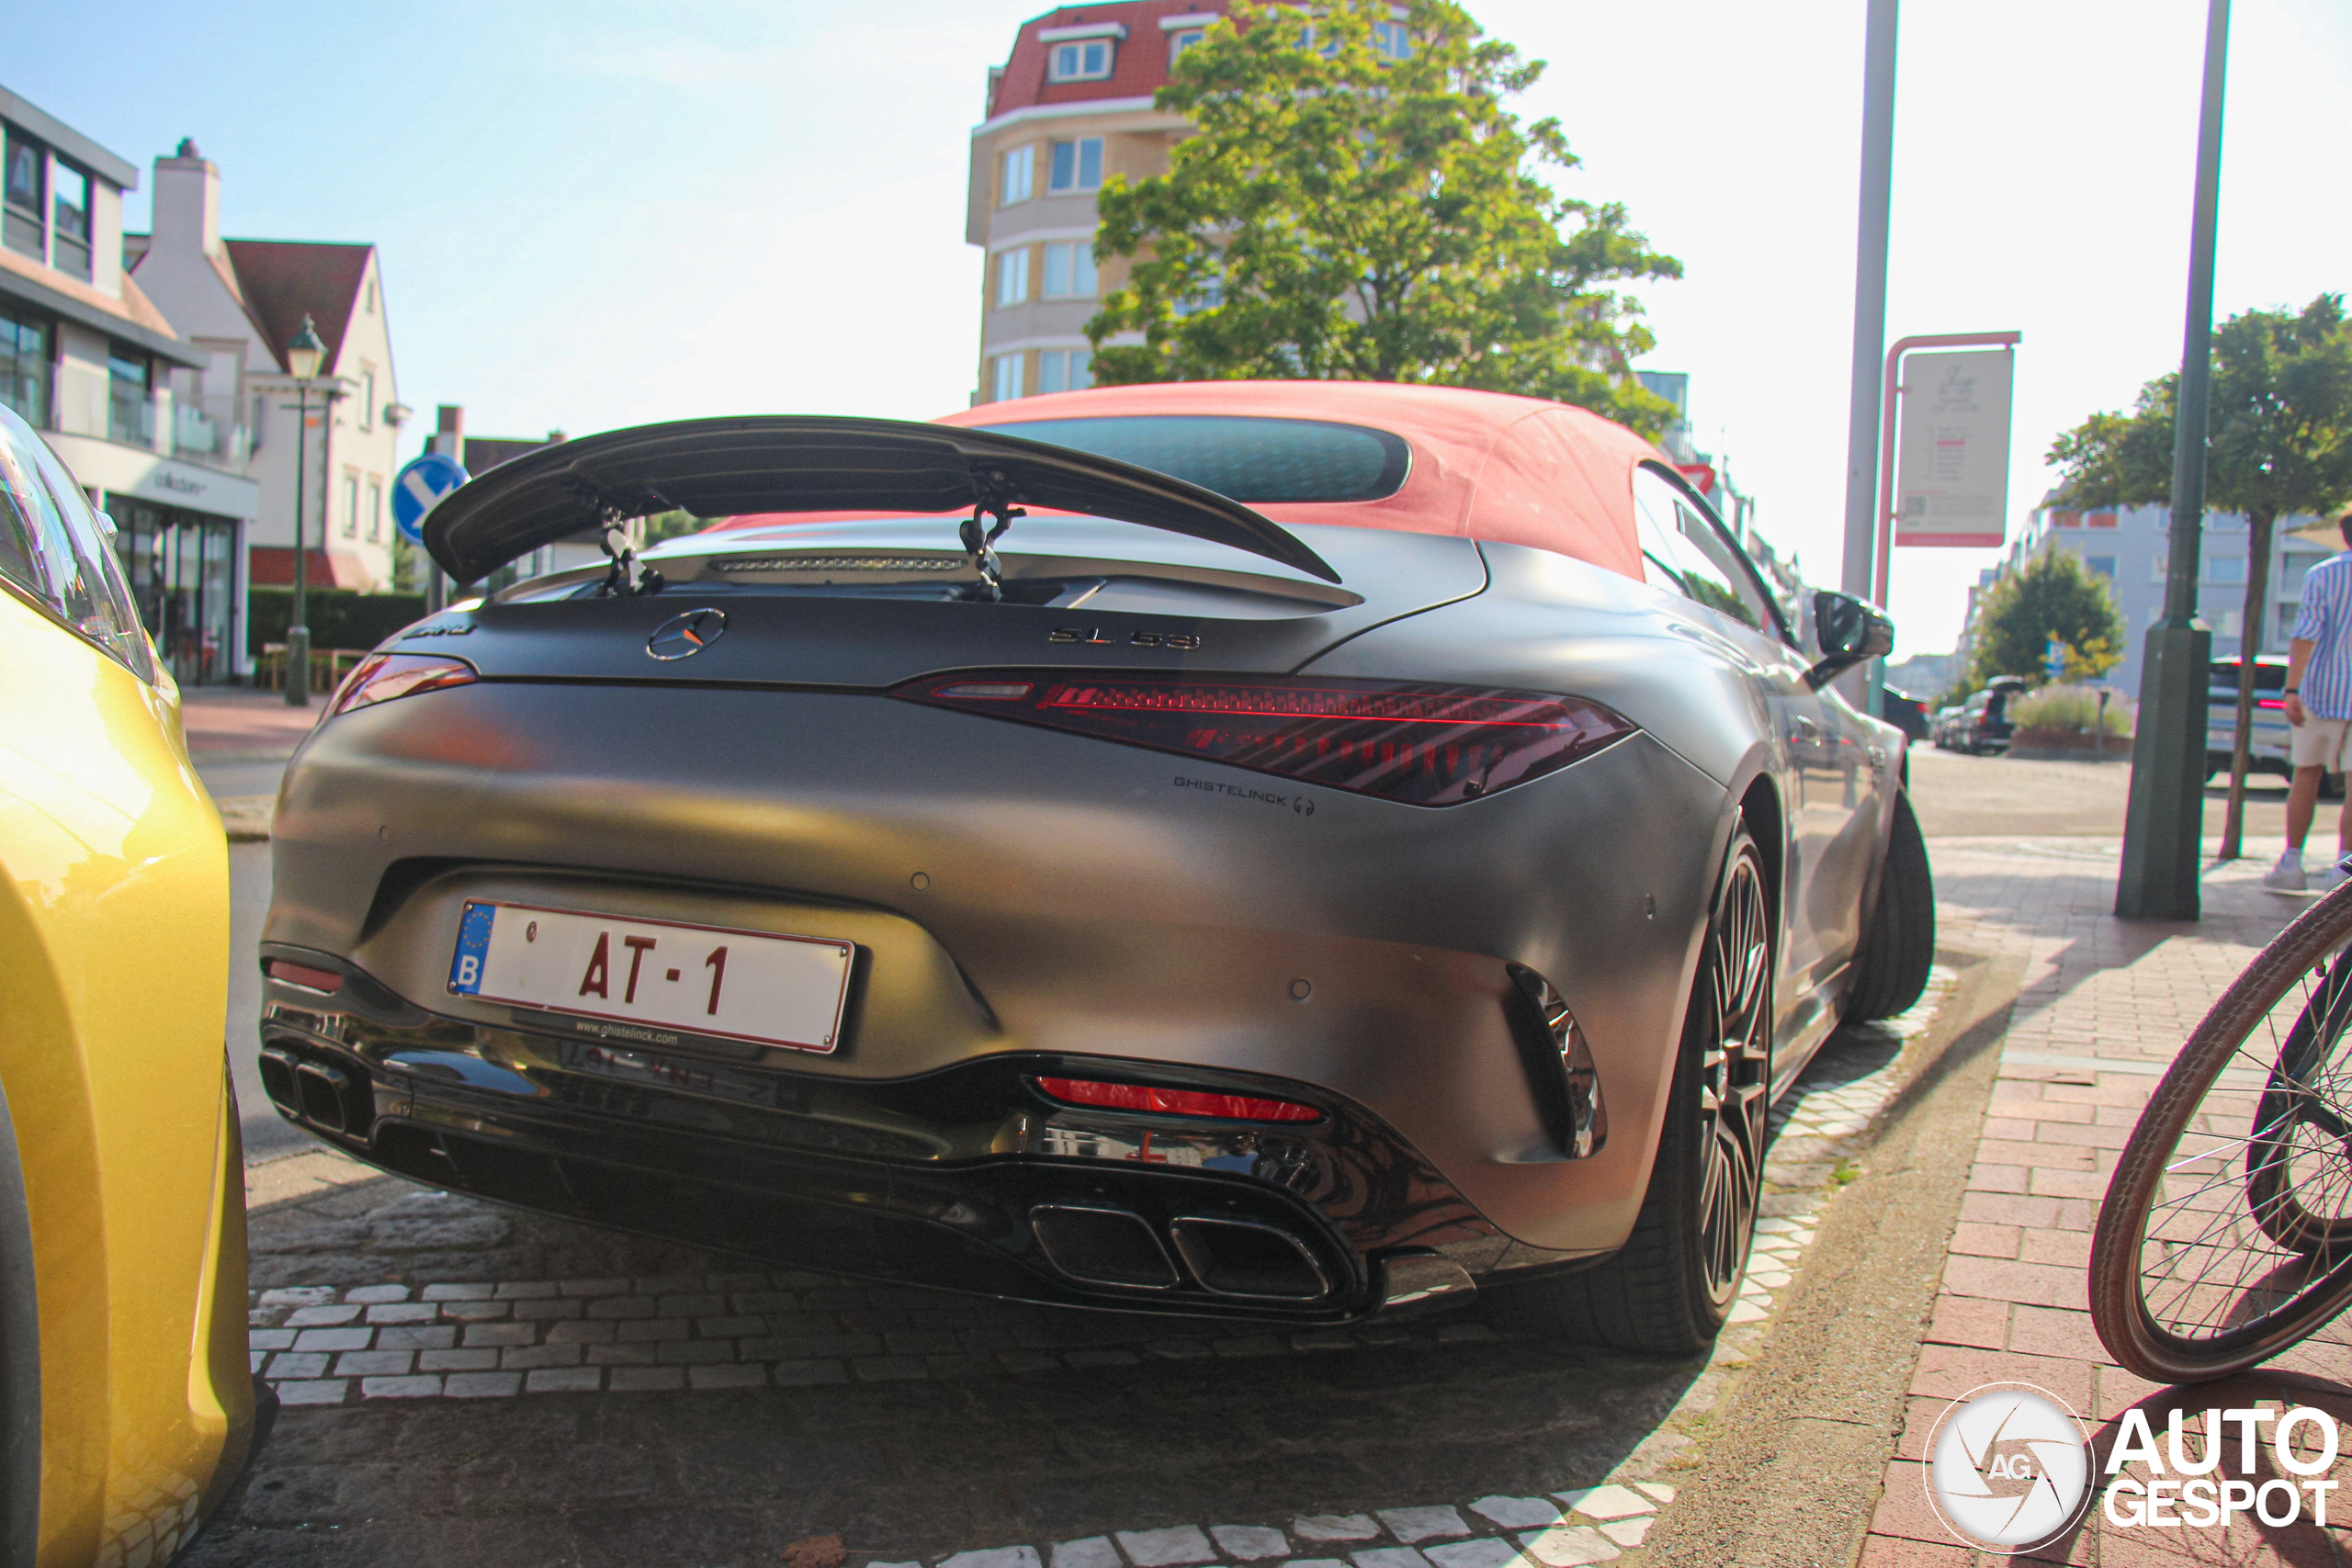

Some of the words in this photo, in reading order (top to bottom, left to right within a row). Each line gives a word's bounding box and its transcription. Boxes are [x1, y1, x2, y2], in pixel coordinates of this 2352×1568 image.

[1049, 627, 1117, 643] SL
[1130, 631, 1201, 650] 63
[1173, 776, 1287, 807] GHISTELINCK
[458, 954, 480, 986] B
[575, 1020, 679, 1046] www.ghistelinck.com
